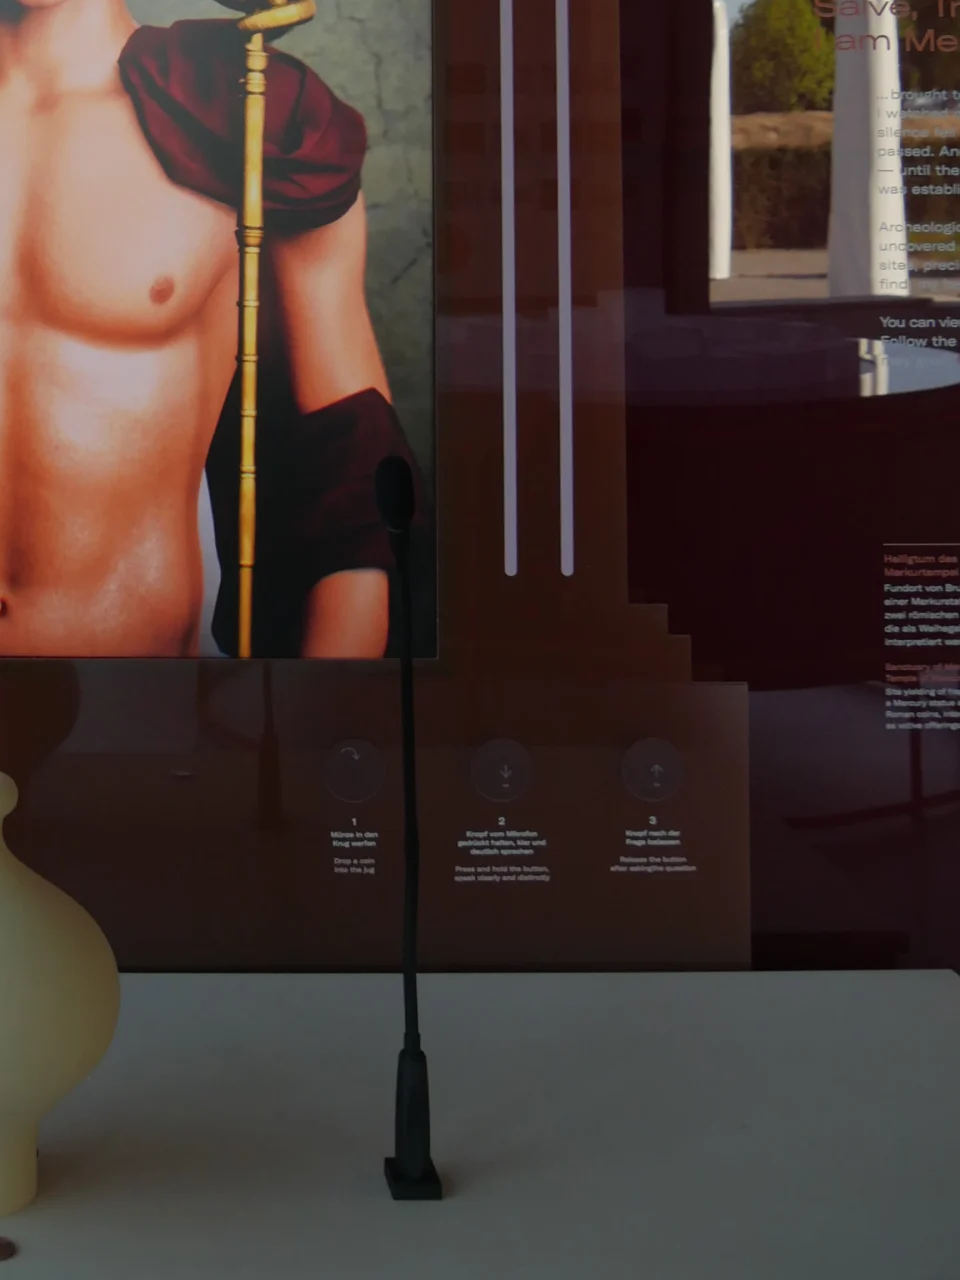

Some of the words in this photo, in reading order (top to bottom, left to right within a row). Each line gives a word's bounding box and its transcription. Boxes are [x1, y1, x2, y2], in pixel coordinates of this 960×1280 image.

[835, 34, 890, 50] am
[878, 146, 934, 157] passed.
[900, 165, 931, 176] until
[878, 186, 908, 195] was
[879, 241, 956, 252] uncovered
[879, 261, 918, 272] sites,
[879, 278, 908, 289] find
[879, 317, 906, 328] You
[909, 319, 936, 328] can
[938, 317, 960, 328] vie
[880, 336, 928, 347] Follow
[931, 335, 957, 348] the
[883, 554, 936, 565] Heiligtum
[883, 584, 923, 593] Fundort
[924, 585, 944, 593] von
[883, 597, 909, 606] einer
[352, 818, 356, 826] 1
[498, 816, 506, 825] 2
[648, 816, 657, 825] 3
